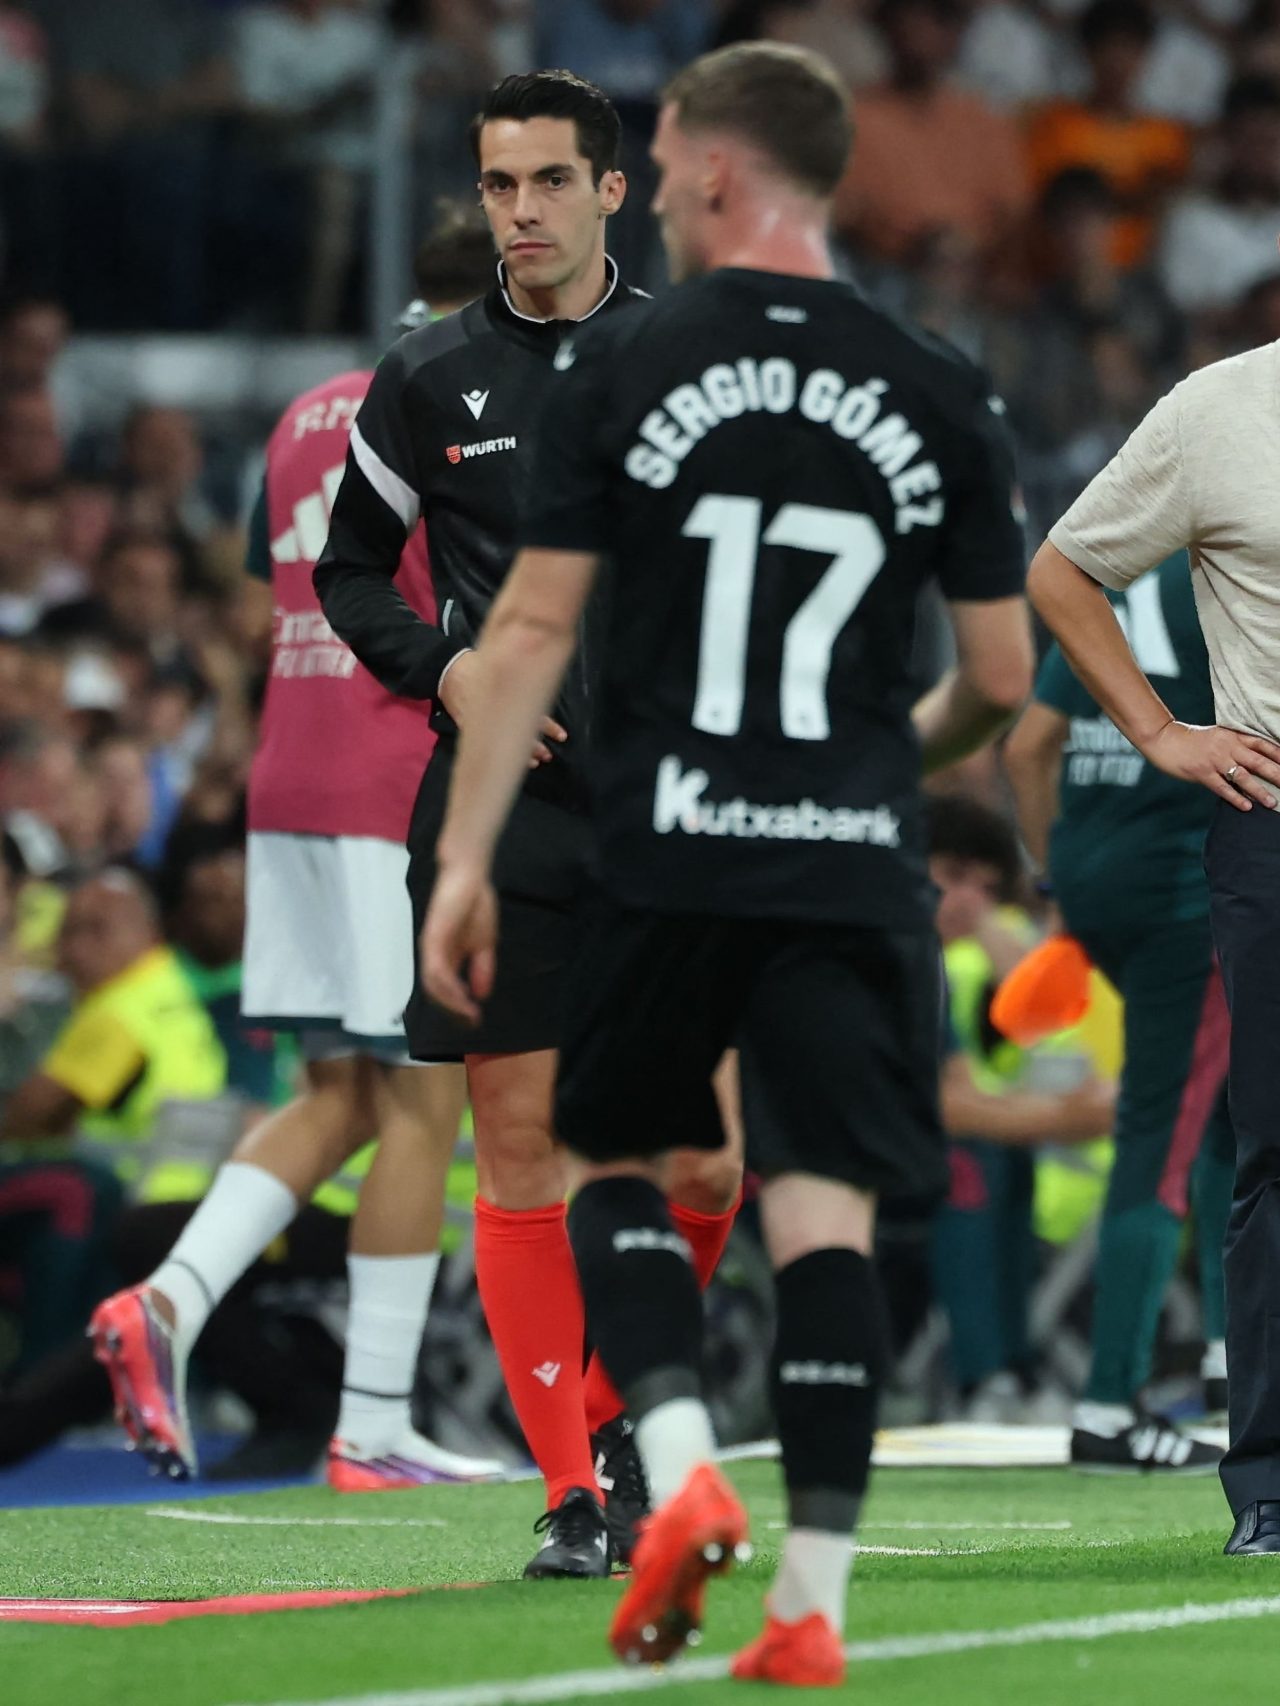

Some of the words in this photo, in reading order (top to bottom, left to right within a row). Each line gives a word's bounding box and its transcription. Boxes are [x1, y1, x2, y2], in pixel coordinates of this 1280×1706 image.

[624, 356, 797, 490] SERGIO
[799, 368, 945, 534] GÓMEZ
[680, 492, 888, 741] 17
